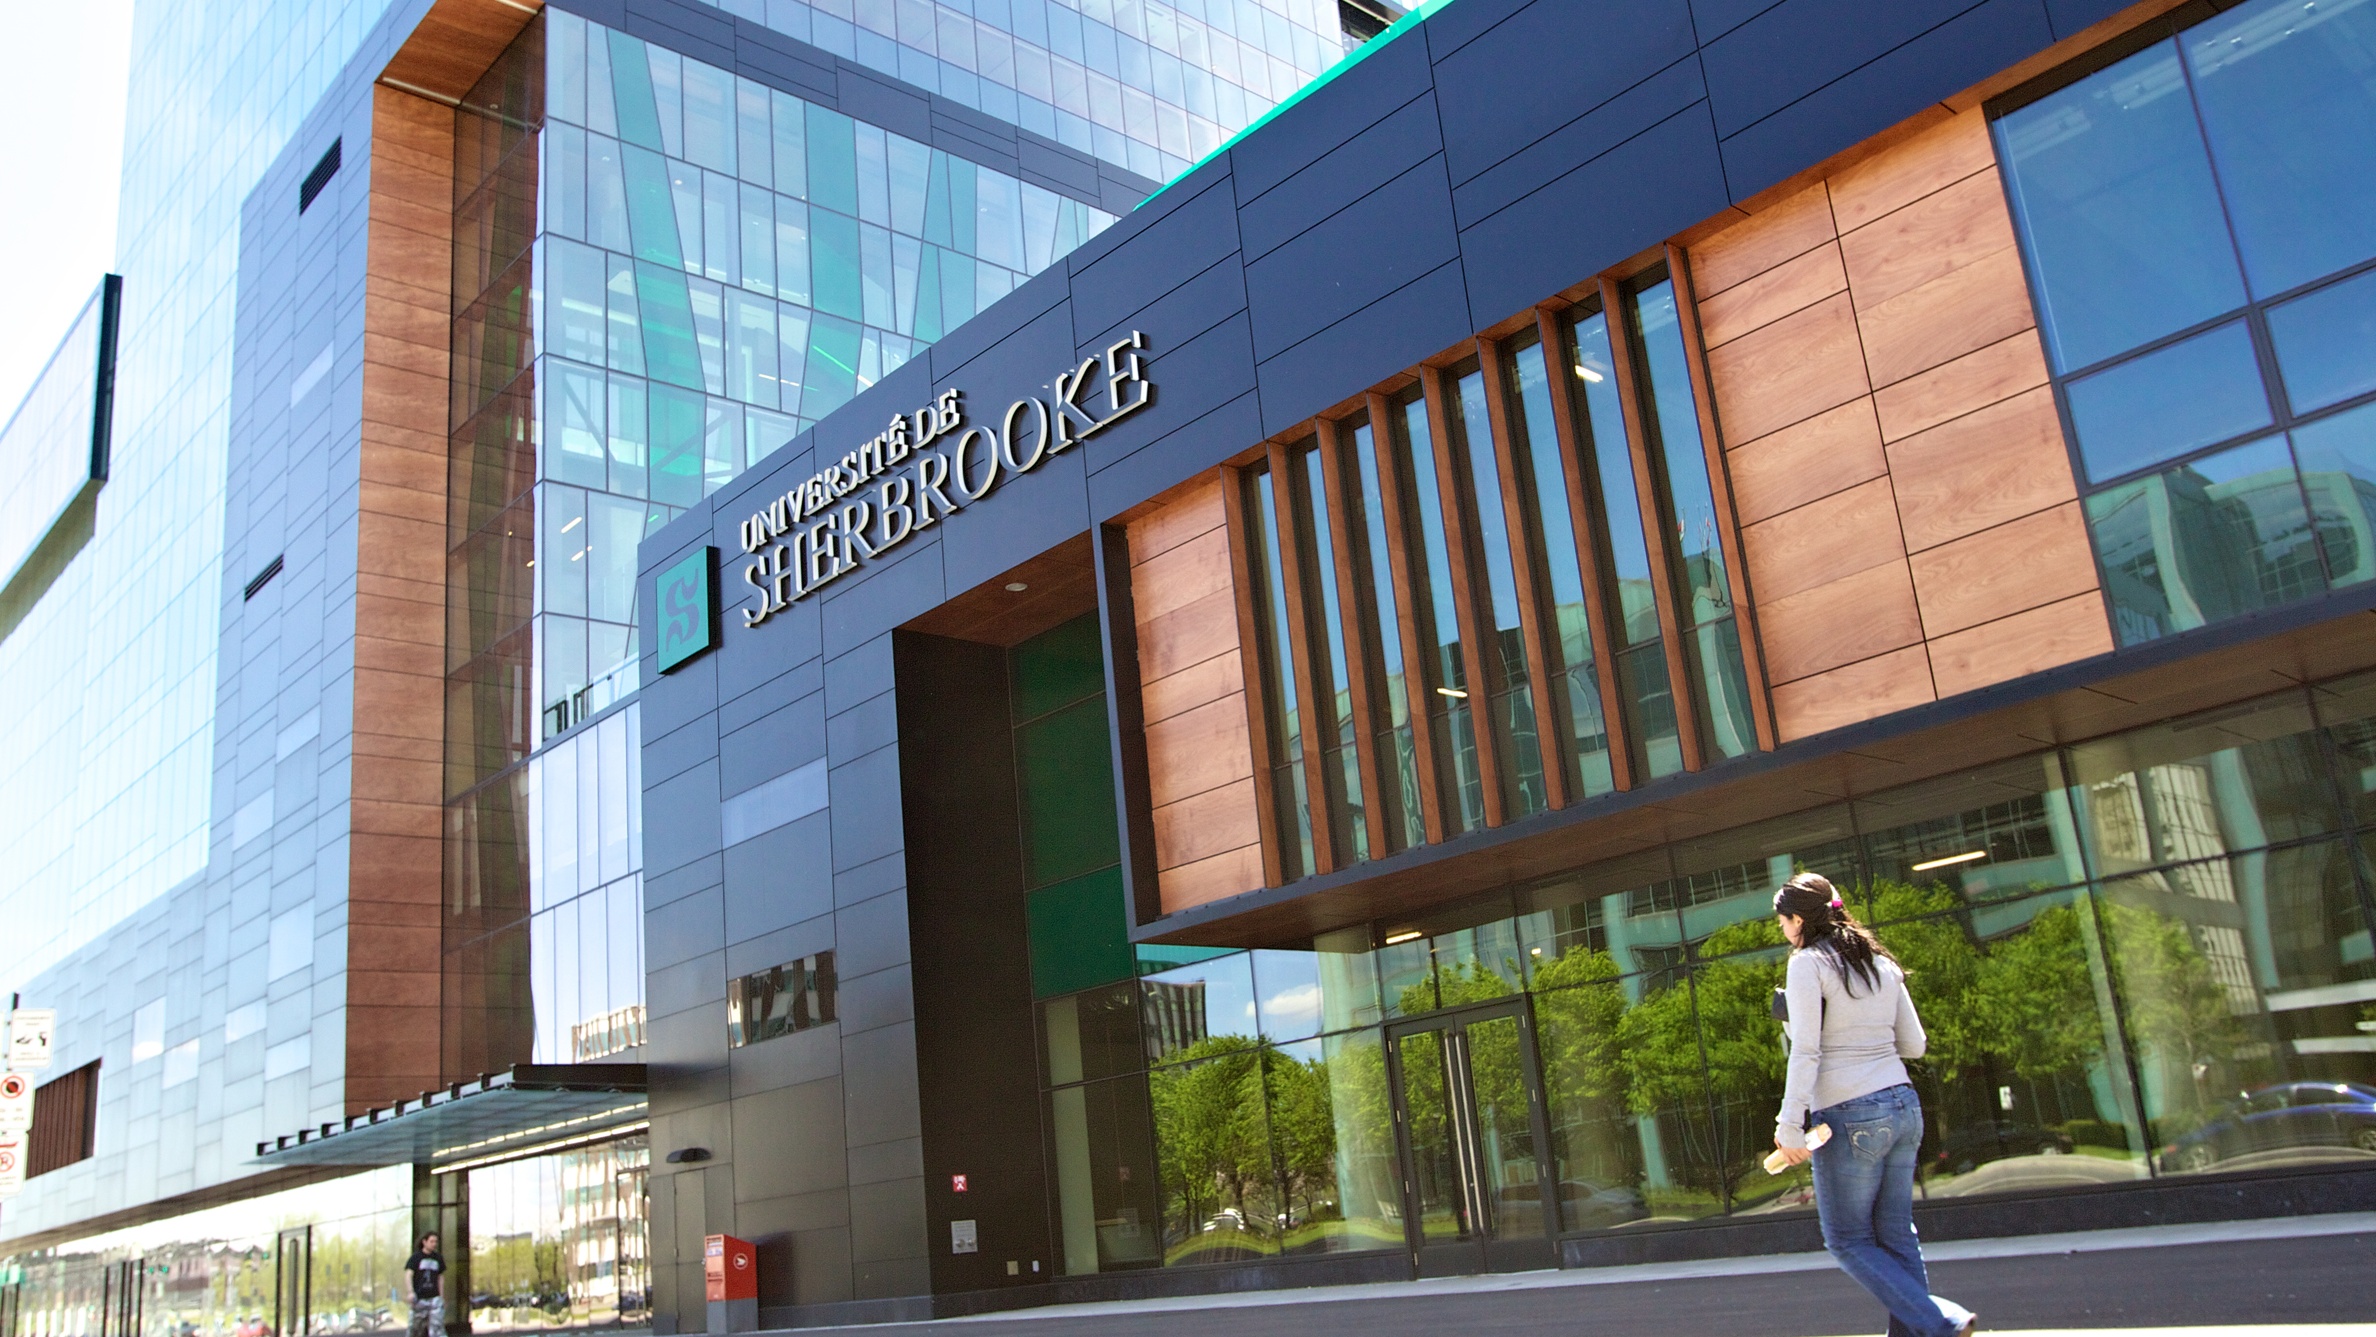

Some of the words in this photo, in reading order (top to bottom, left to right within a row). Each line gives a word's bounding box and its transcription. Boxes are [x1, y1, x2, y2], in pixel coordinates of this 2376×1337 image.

[740, 413, 909, 553] UNIVERSITÉ
[911, 387, 961, 450] DE
[742, 329, 1150, 628] SHERBROOKE
